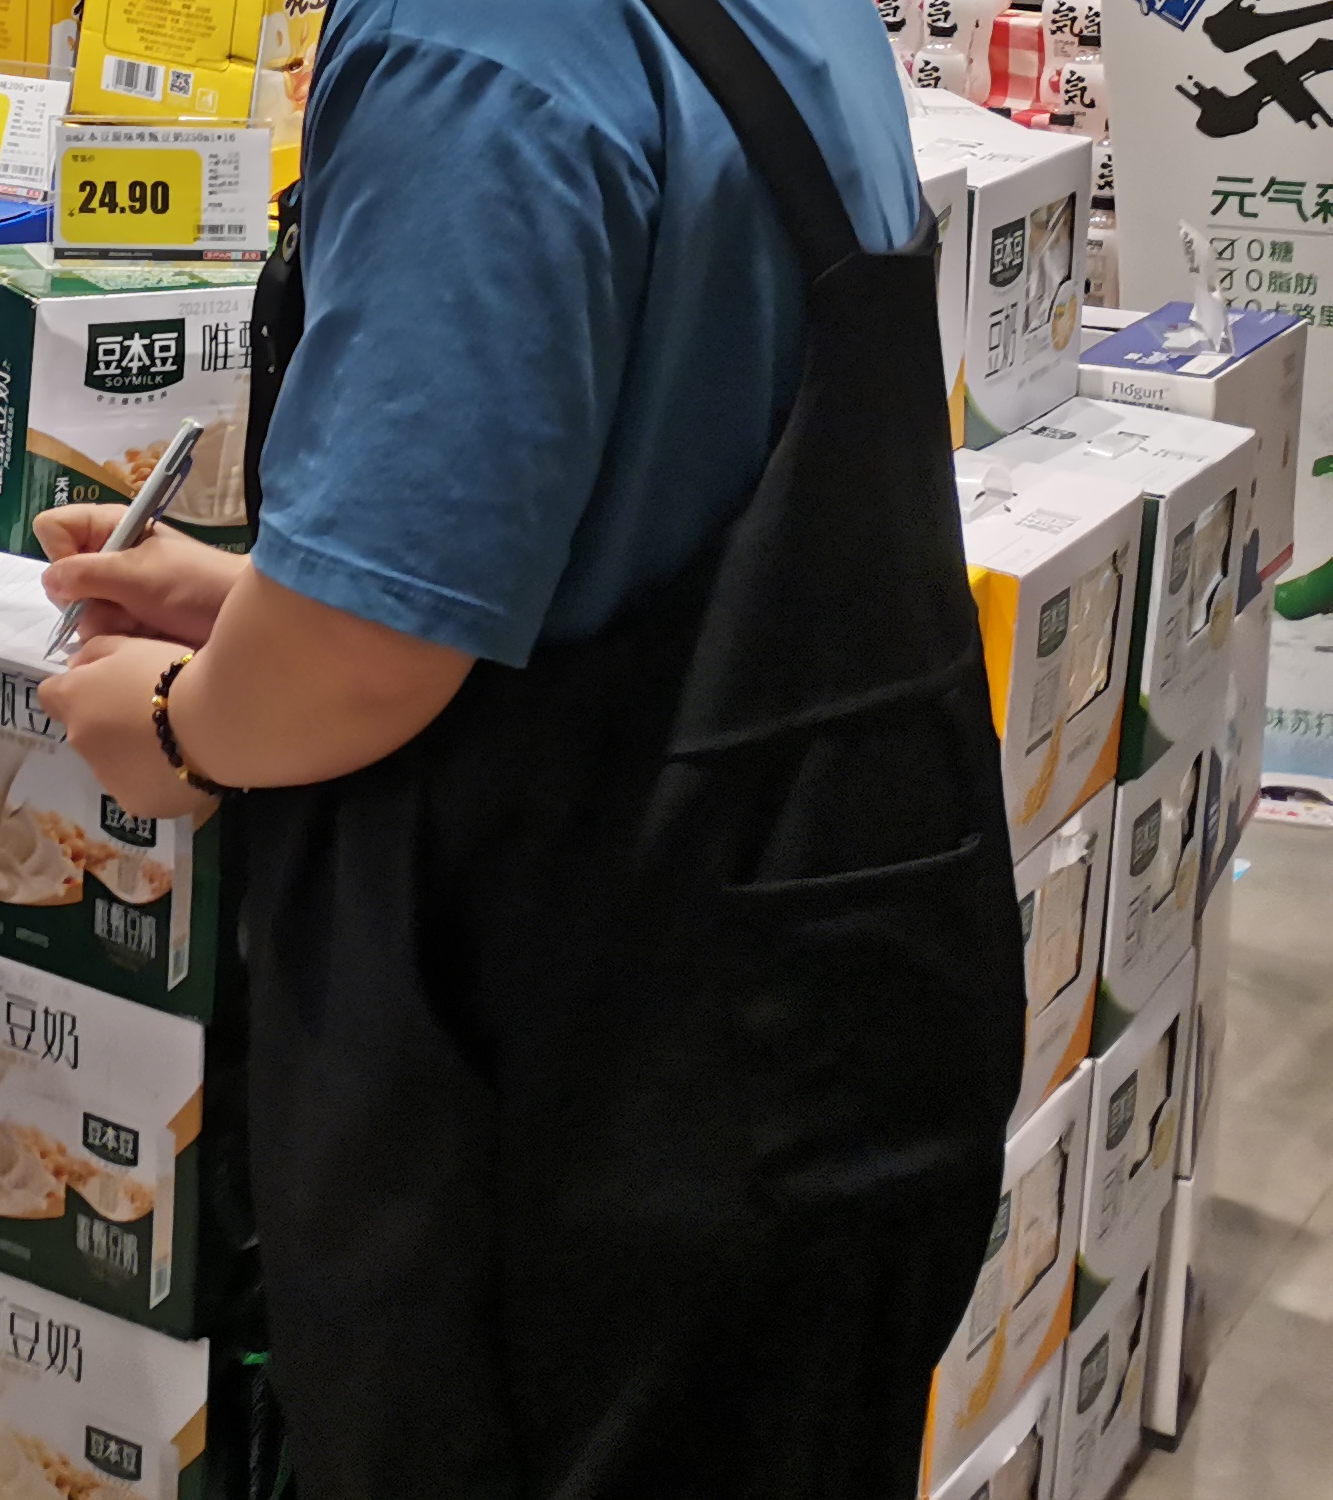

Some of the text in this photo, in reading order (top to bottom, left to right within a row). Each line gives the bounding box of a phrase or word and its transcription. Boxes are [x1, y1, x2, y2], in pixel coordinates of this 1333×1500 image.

[78, 180, 170, 215] 24.90
[93, 331, 179, 376] 豆本豆
[105, 373, 164, 388] SOYMILK
